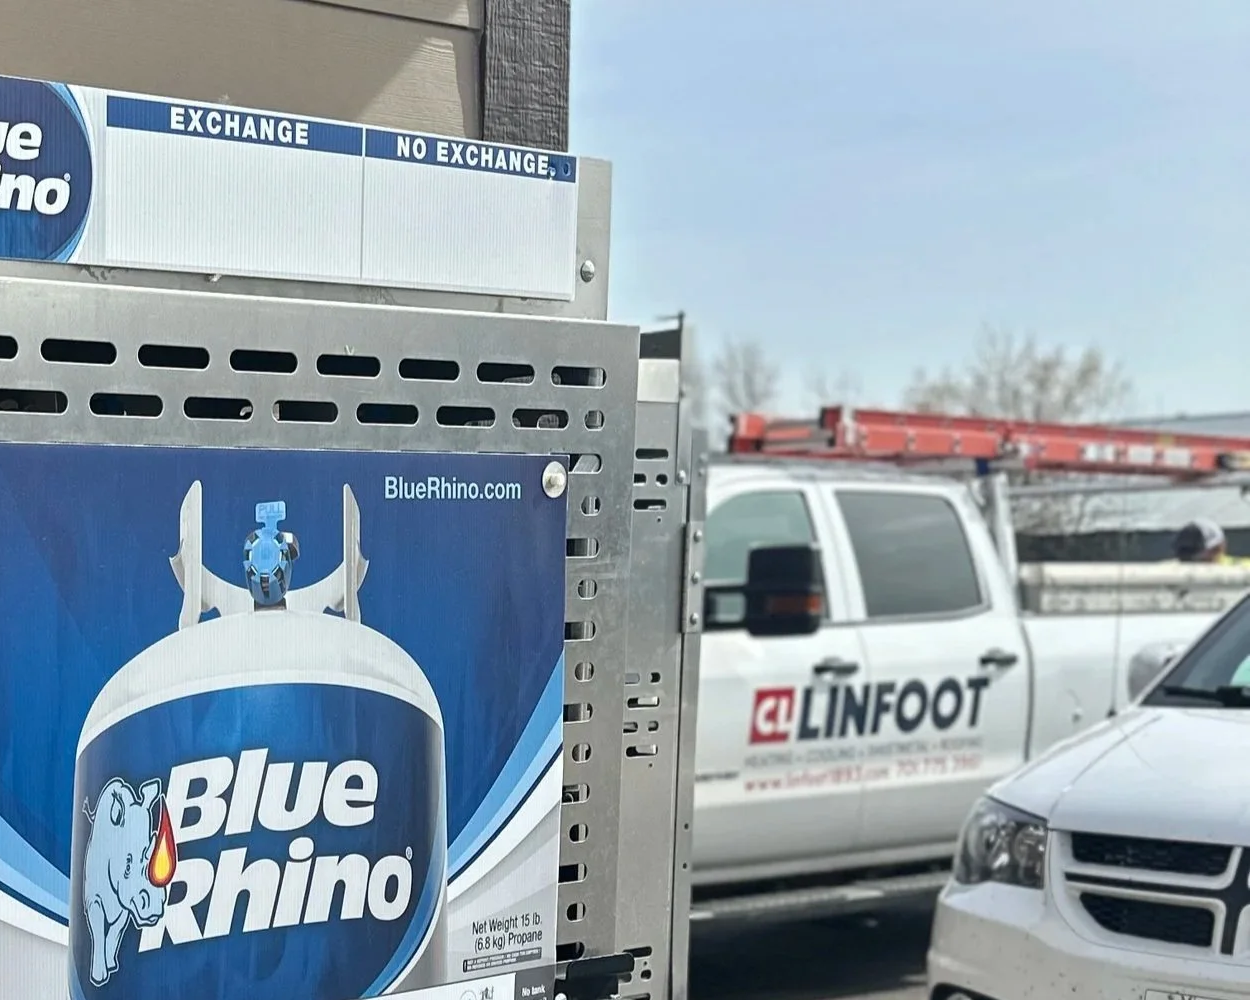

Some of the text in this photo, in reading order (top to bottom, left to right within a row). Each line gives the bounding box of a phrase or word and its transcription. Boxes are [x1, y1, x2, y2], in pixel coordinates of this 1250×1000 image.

[169, 106, 309, 145] EXCHANGE
[396, 136, 549, 176] NO EXCHANGE
[384, 476, 521, 499] BlueRhino.com
[796, 677, 991, 742] LINFOOT
[166, 748, 379, 844] Blue
[472, 912, 542, 935] Net Weight 15 lb.
[474, 930, 543, 954] (6.8 kg) Propane
[522, 984, 545, 997] No tank
